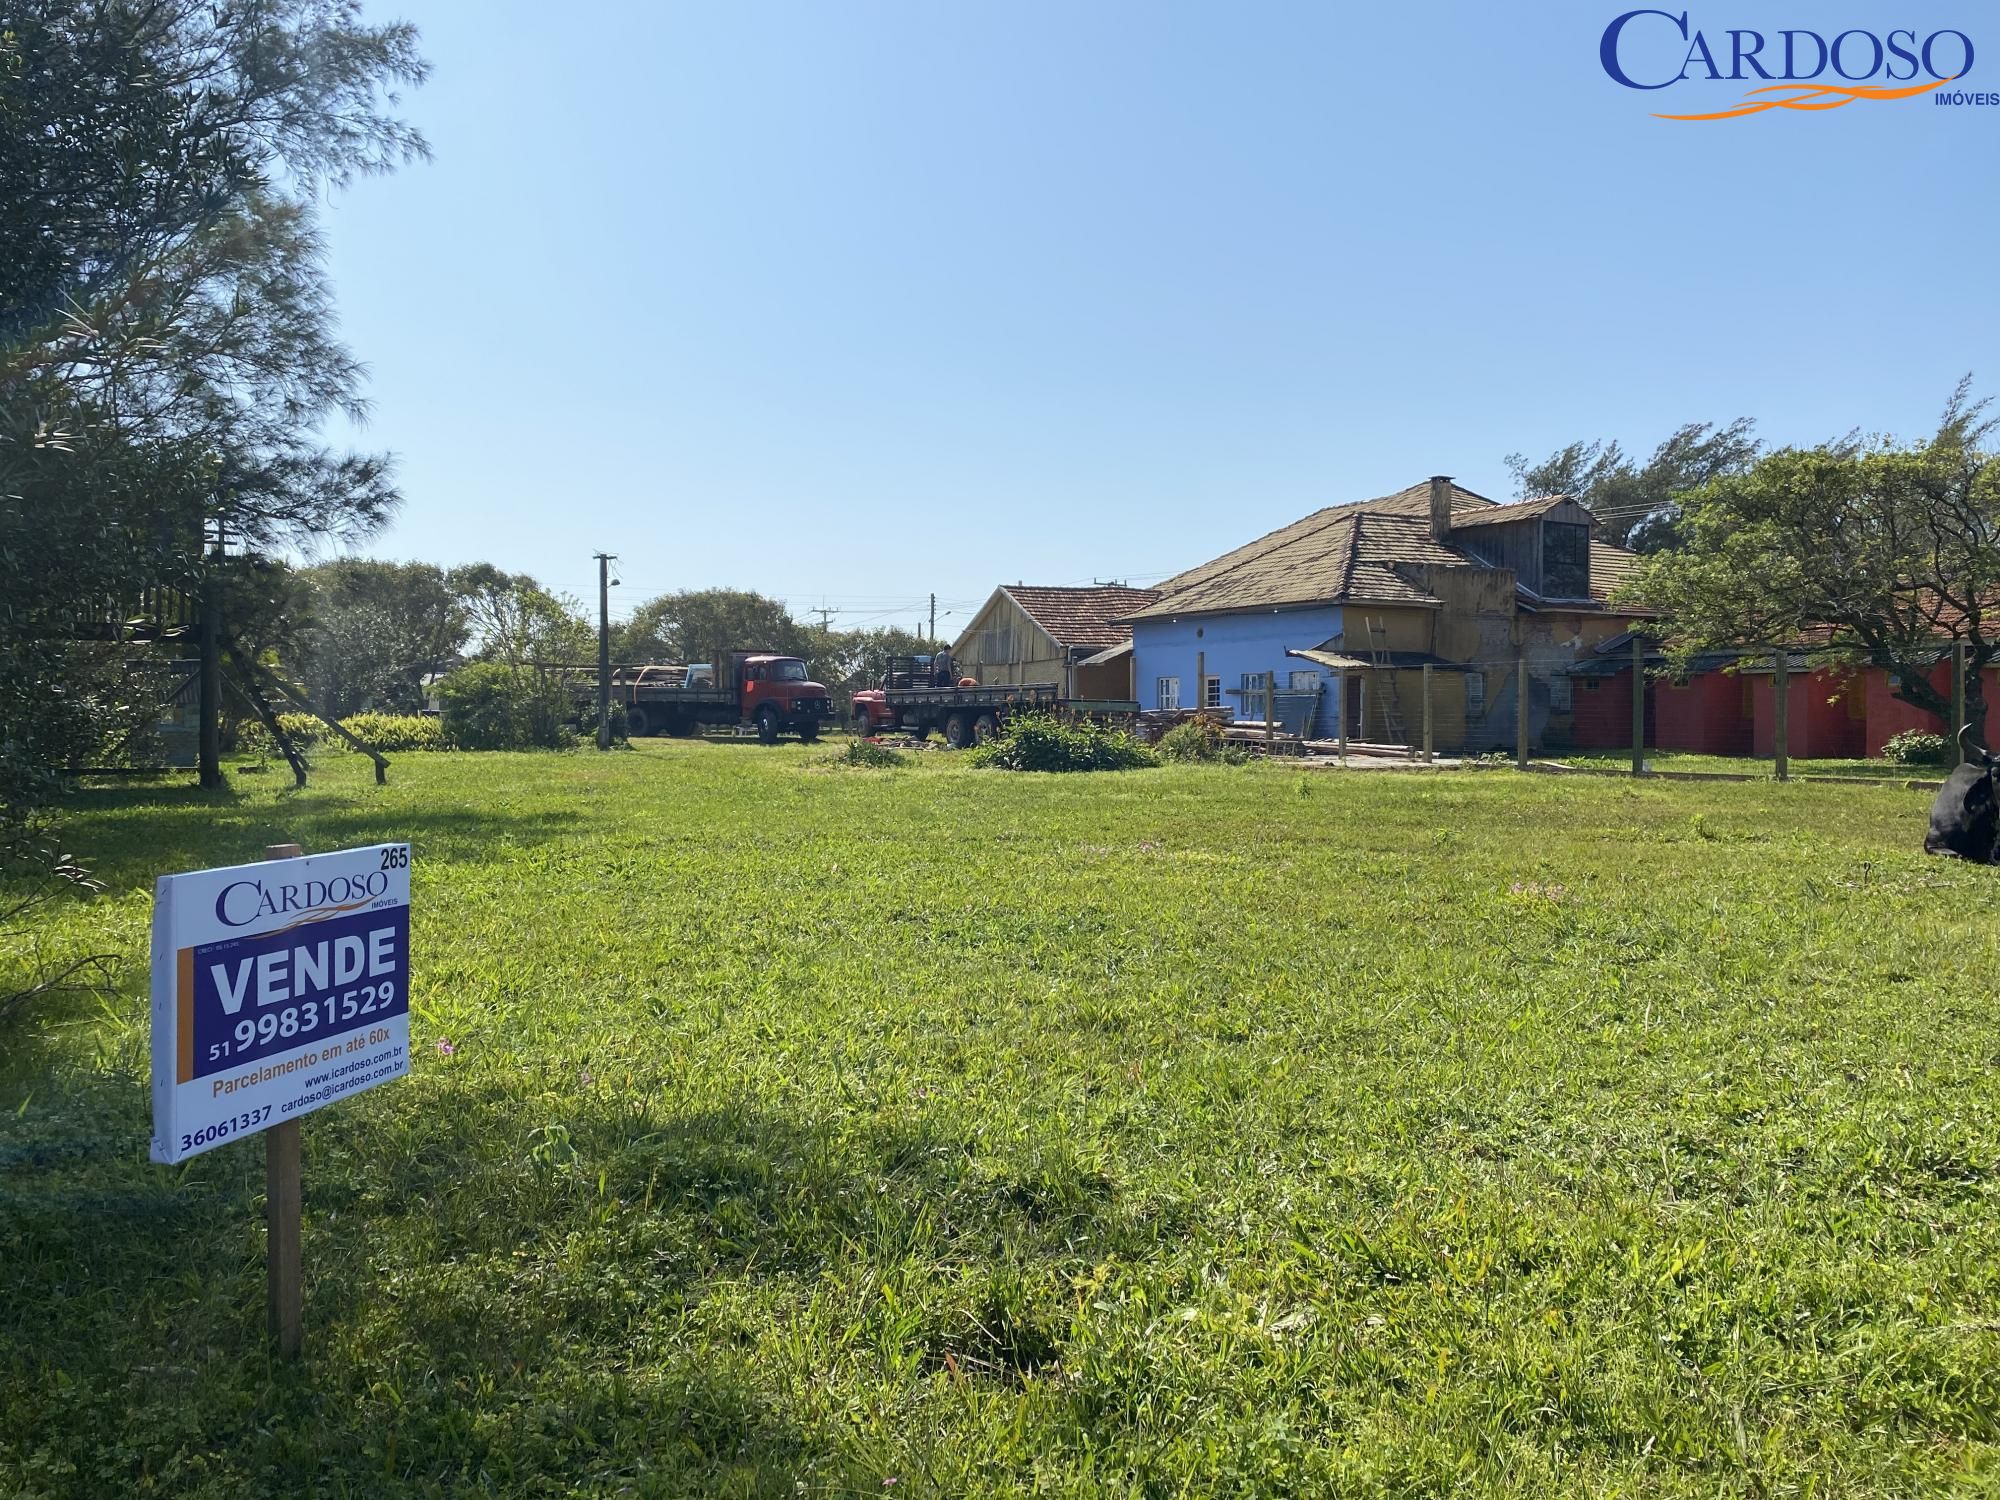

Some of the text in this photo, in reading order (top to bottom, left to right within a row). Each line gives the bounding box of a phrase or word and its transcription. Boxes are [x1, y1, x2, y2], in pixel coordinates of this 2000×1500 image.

[380, 847, 408, 870] 265
[215, 871, 388, 927] CARDOSO
[371, 898, 398, 910] IMÓVEIS
[210, 926, 396, 1015] VENDE
[209, 980, 395, 1061] 51 99831529
[212, 1027, 390, 1098] Parcelamento em até 60x
[281, 1062, 404, 1113] cardoso@icardoso.com.br
[305, 1046, 403, 1089] www.icardoso.com.br
[181, 1104, 272, 1152] 36061337
